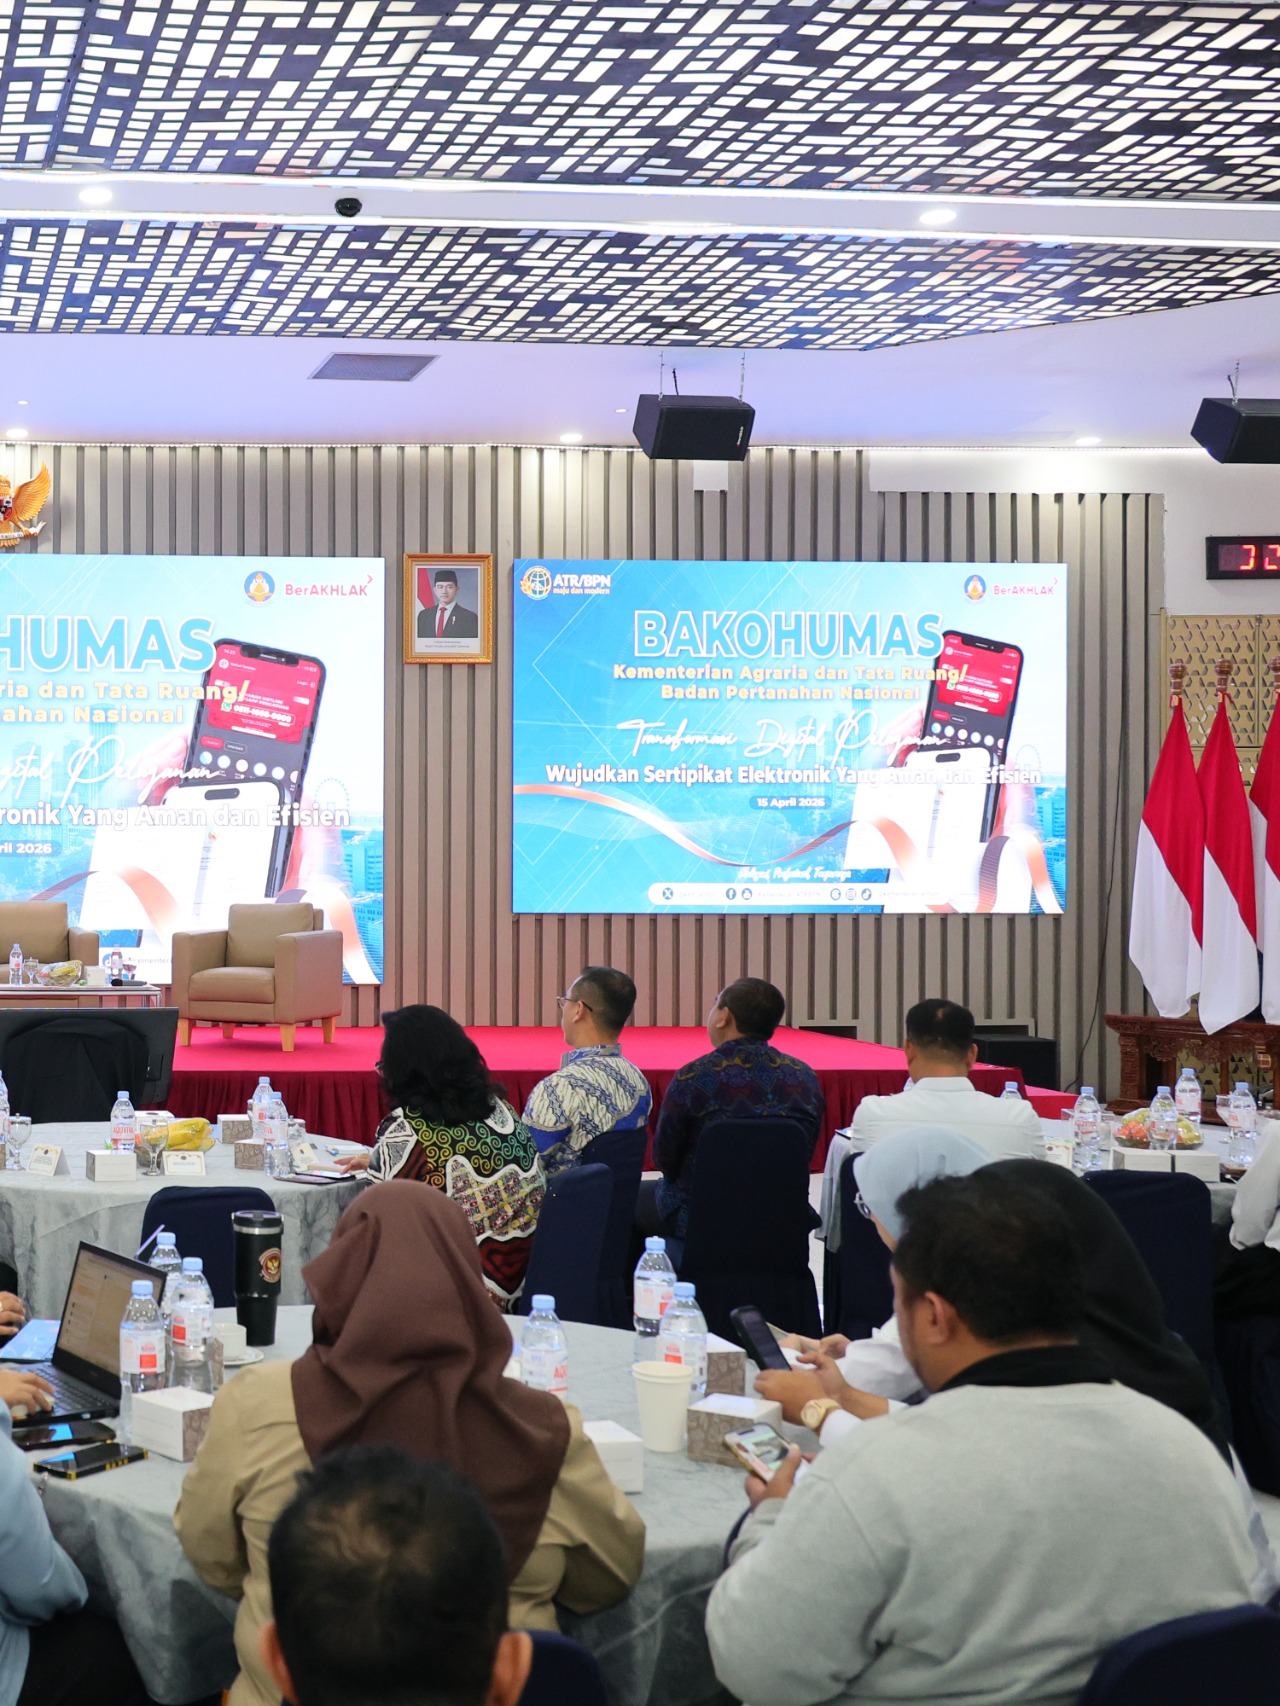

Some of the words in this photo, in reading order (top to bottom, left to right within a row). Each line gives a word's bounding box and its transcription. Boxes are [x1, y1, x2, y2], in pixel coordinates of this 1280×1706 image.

[553, 574, 611, 588] ATR/BPN
[284, 584, 369, 597] BerAKHLAK
[553, 587, 570, 596] maju
[992, 584, 1055, 596] BerAKHLAK
[634, 610, 944, 660] BAKOHUMAS
[613, 664, 734, 680] Kementerian
[738, 665, 809, 684] Agraria
[814, 666, 848, 680] dan
[854, 666, 896, 681] Tata
[38, 682, 85, 700] dan
[93, 682, 144, 700] Tata
[661, 684, 720, 700] Badan
[726, 684, 835, 700] Pertanahan
[840, 685, 920, 700] Nasional
[73, 706, 184, 724] Nasional
[616, 718, 738, 758] Transformasi
[743, 718, 828, 763] Digital
[545, 762, 640, 787] Wujudkan
[644, 764, 733, 788] Sertipikat
[738, 766, 832, 785] Elektronik
[834, 766, 880, 788] Yang
[886, 766, 938, 785] Aman
[941, 766, 977, 785] dan
[982, 764, 1042, 785] Efisien
[756, 798, 769, 808] 15
[770, 798, 797, 810] April
[67, 804, 129, 832] Yang
[134, 804, 208, 827] Aman
[212, 802, 260, 827] dan
[266, 802, 351, 827] Efisien
[16, 842, 52, 854] 2026
